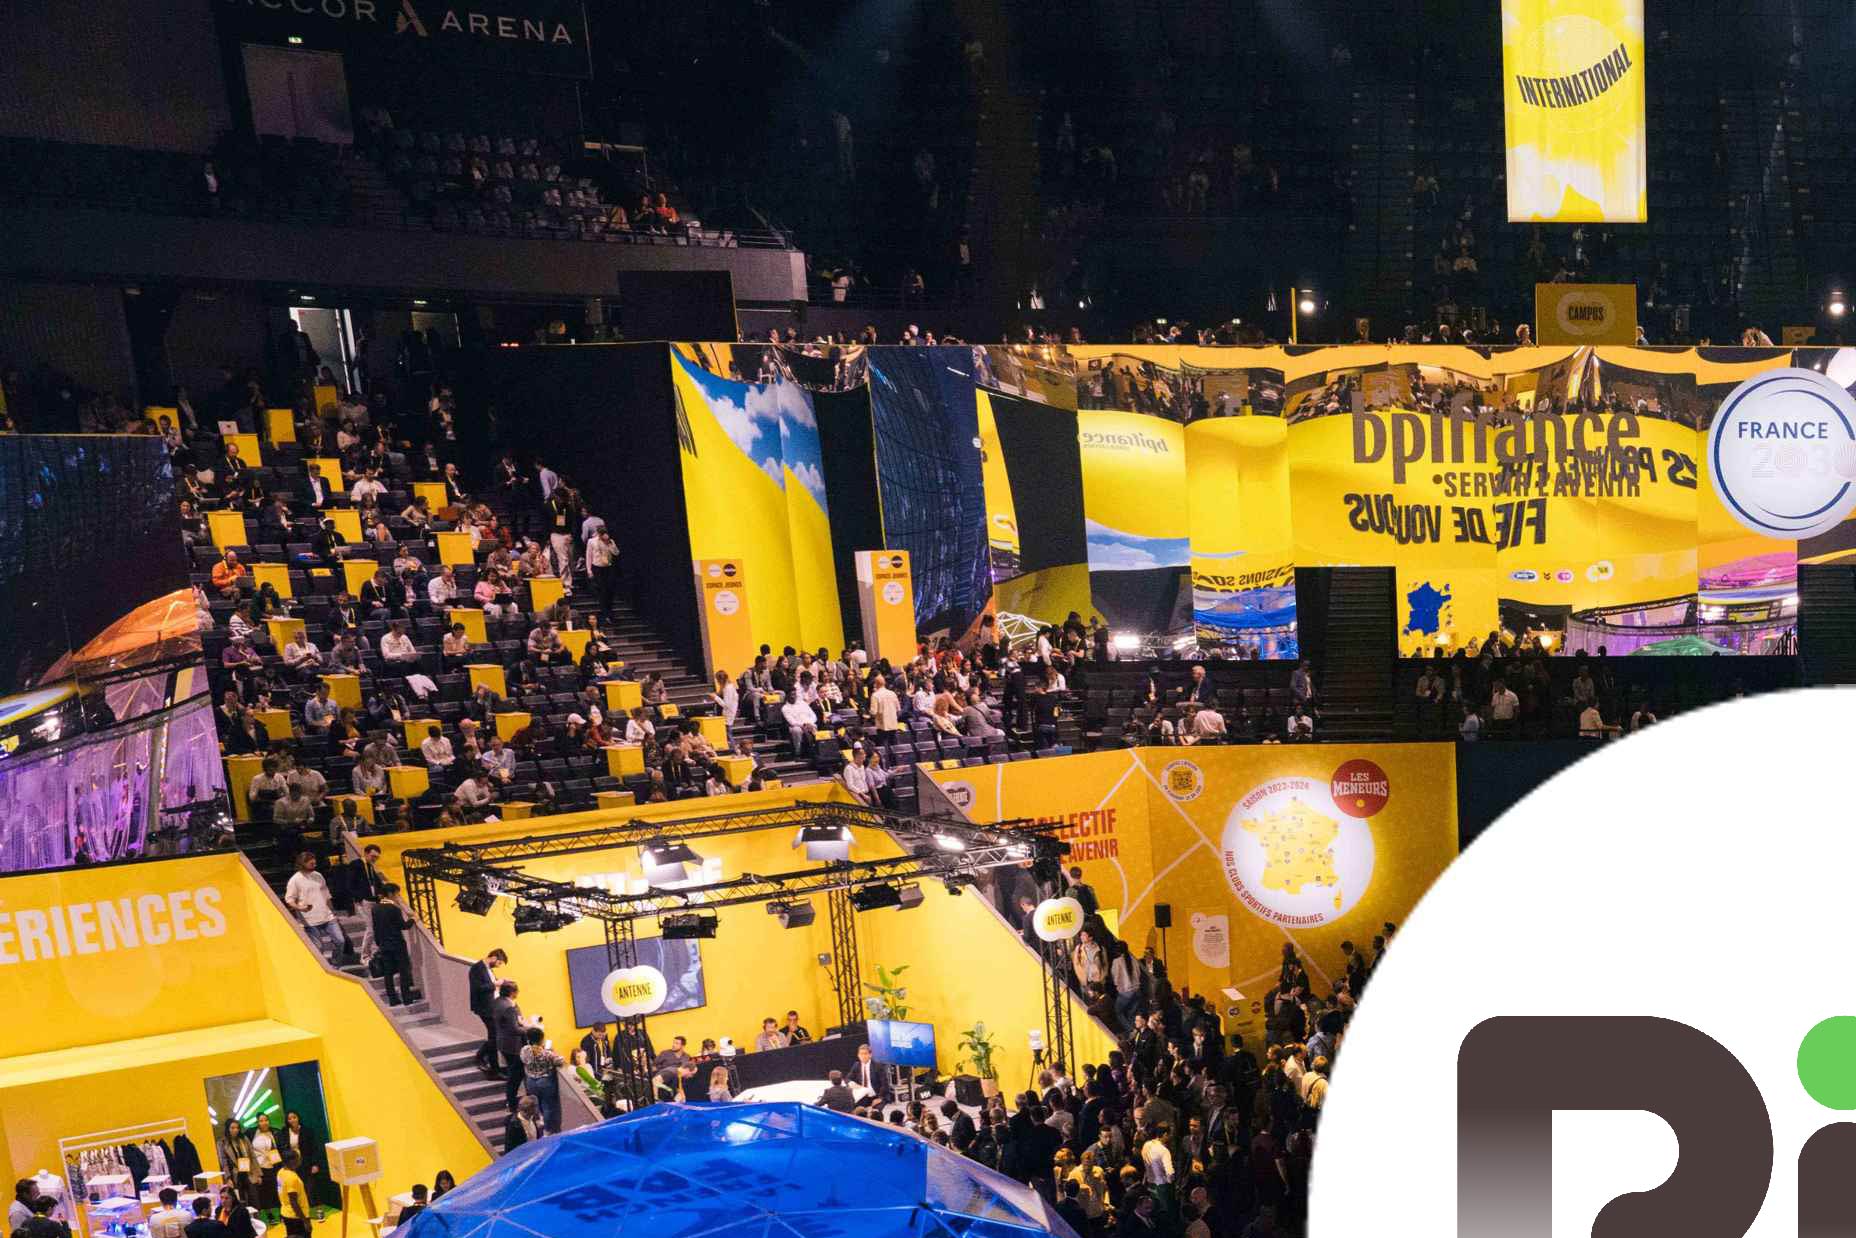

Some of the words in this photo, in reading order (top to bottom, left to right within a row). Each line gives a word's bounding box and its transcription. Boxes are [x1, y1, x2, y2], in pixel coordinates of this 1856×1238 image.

[226, 0, 376, 21] COR
[441, 11, 573, 45] ARENA
[1516, 43, 1632, 109] INTERNATIONAL
[1568, 306, 1604, 321] CAMPUS
[1352, 392, 1640, 485] bpifrance
[1738, 422, 1828, 439] FRANCE
[1333, 780, 1387, 796] MENEURS
[1350, 772, 1369, 781] LES
[1059, 838, 1118, 864] AVENIR
[1227, 867, 1243, 893] CLUBS
[1241, 891, 1272, 918] SPORTIFS
[1272, 911, 1324, 926] PARTENAIRES
